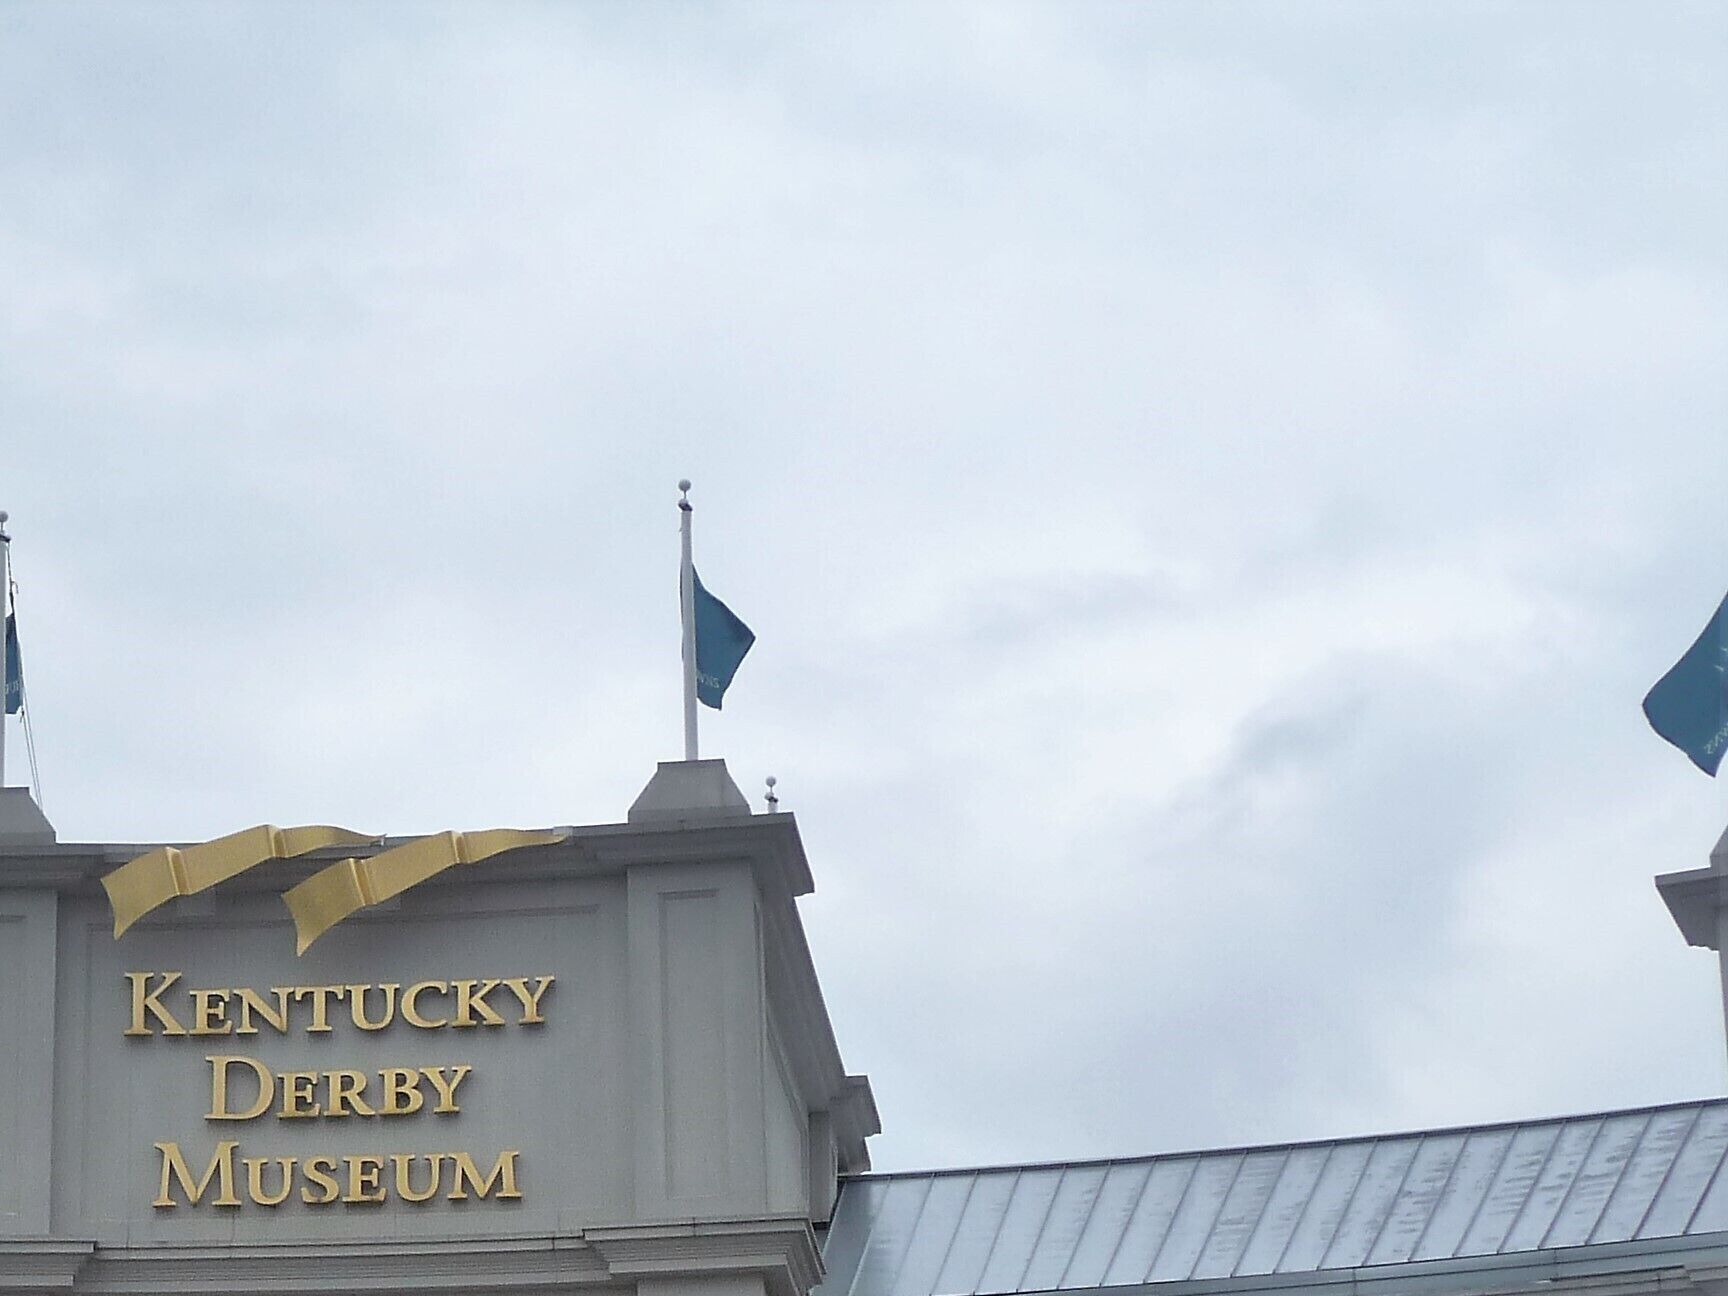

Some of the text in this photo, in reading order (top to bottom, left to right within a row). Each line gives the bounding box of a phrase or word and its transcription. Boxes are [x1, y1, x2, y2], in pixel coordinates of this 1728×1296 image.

[123, 970, 556, 1037] KENTUCKY
[204, 1055, 472, 1121] DERBY
[153, 1140, 522, 1208] MUSEUM
